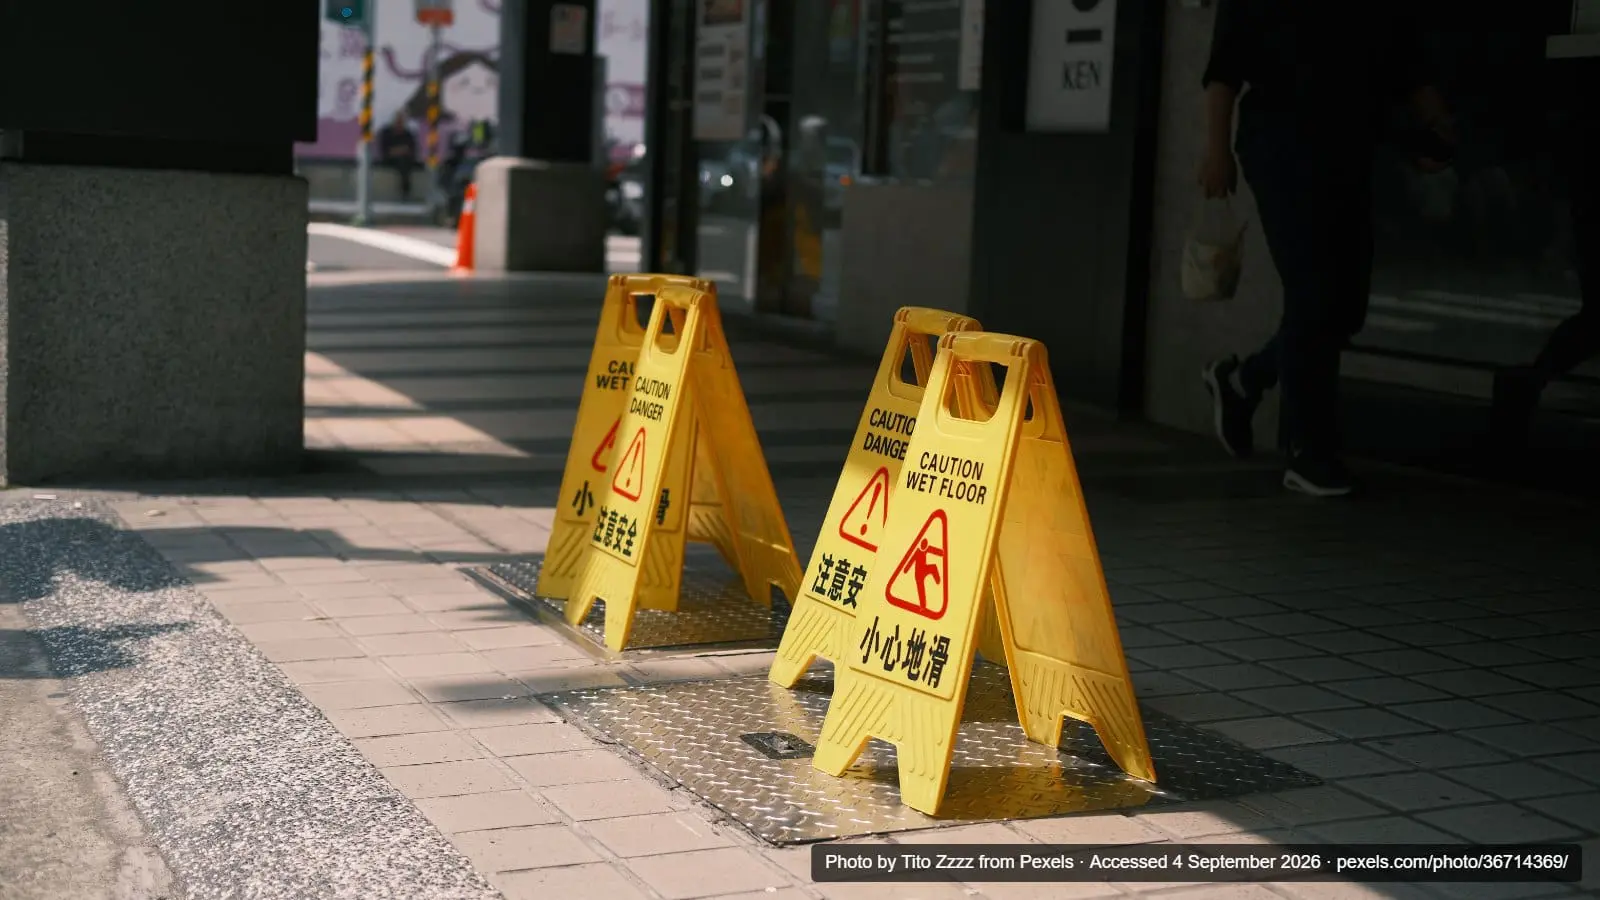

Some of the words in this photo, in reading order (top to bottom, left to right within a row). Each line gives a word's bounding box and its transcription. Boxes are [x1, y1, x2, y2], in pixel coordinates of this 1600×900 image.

[597, 375, 630, 391] WET
[635, 376, 671, 401] CAUTION
[630, 397, 664, 423] DANGER
[870, 408, 916, 436] CAUTIO
[863, 432, 909, 461] DANGE
[920, 451, 984, 481] CAUTION
[906, 471, 938, 494] WET
[939, 477, 987, 505] FLOOR
[593, 505, 637, 557] 注意安全
[812, 552, 867, 609] 注意安
[860, 616, 951, 688] 小心地滑
